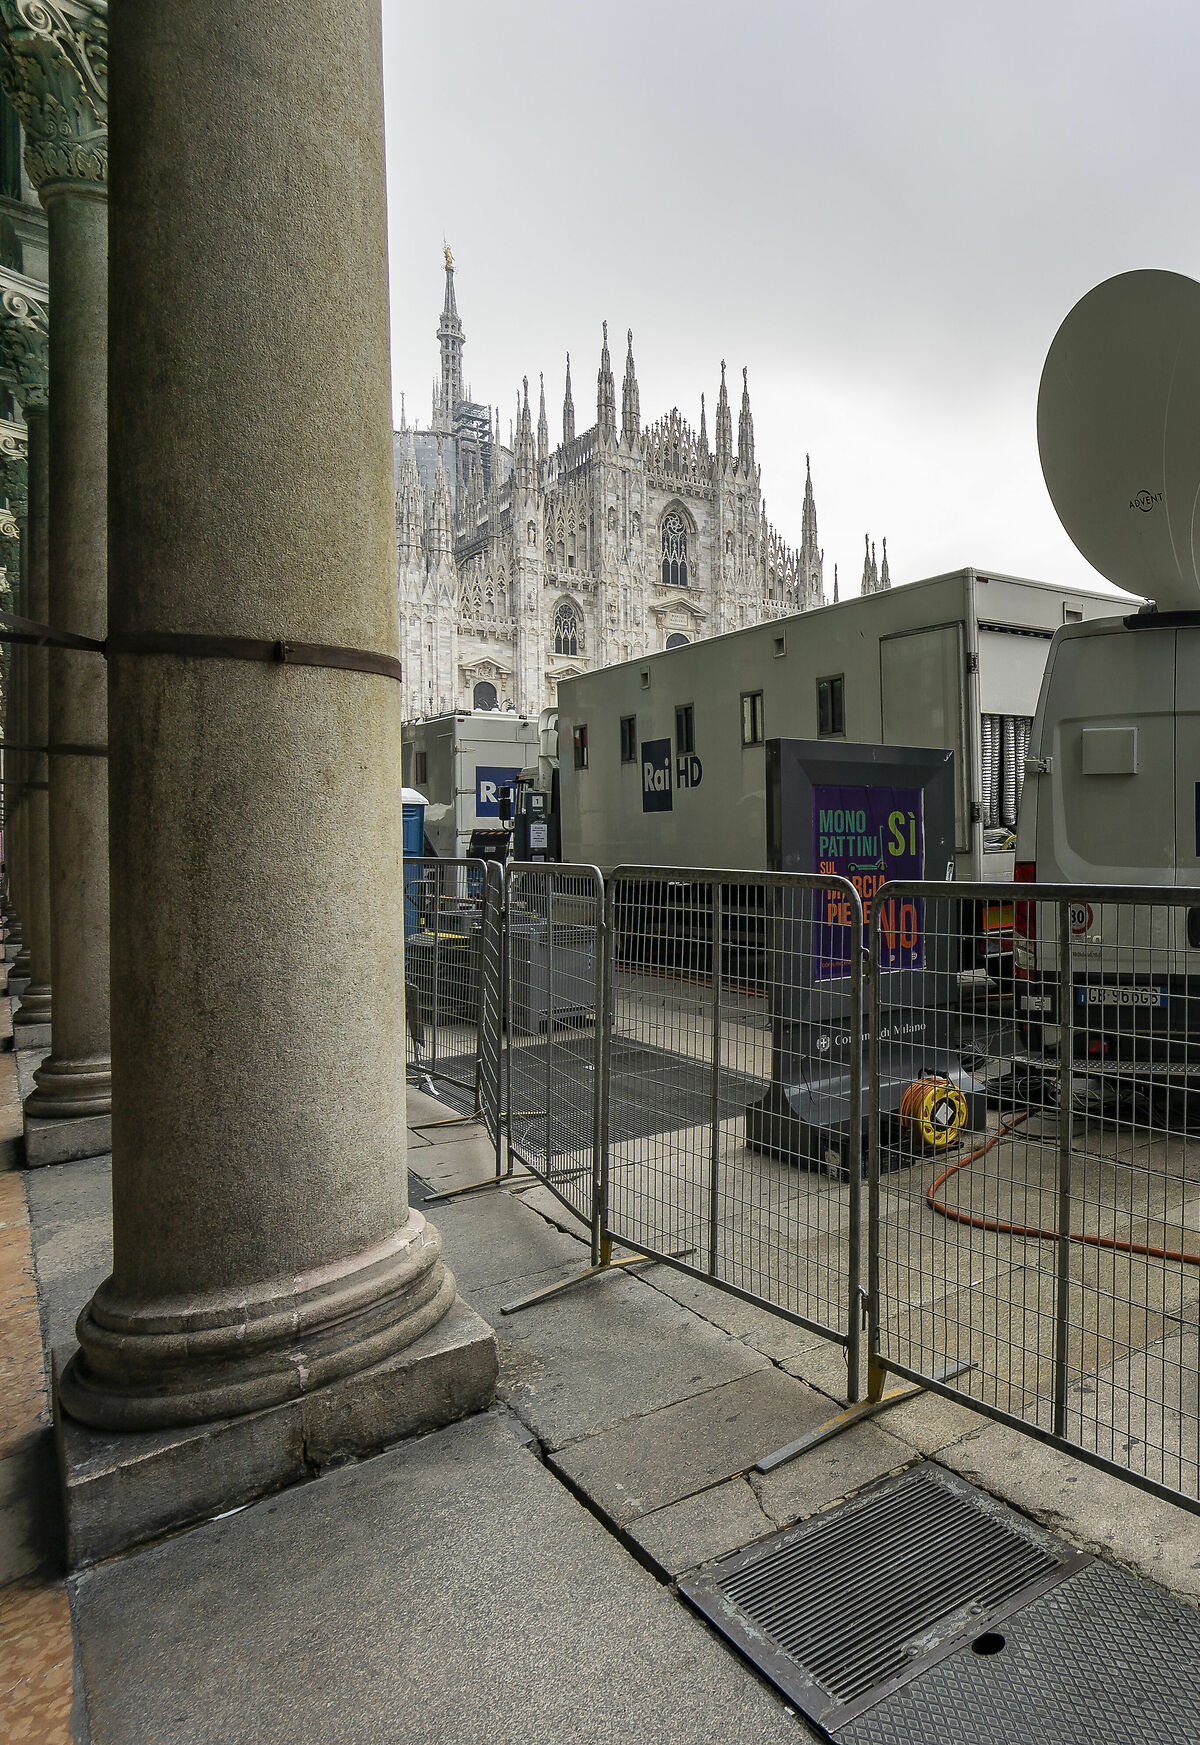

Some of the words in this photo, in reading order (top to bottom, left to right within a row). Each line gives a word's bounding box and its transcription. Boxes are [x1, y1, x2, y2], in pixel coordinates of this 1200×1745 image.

[1129, 492, 1163, 509] ADVENT
[644, 757, 670, 792] Rai
[676, 756, 703, 789] HD
[819, 810, 866, 833] MONO
[819, 835, 877, 857] PATTINI
[820, 861, 837, 875] SUL
[827, 901, 872, 926] PIEE
